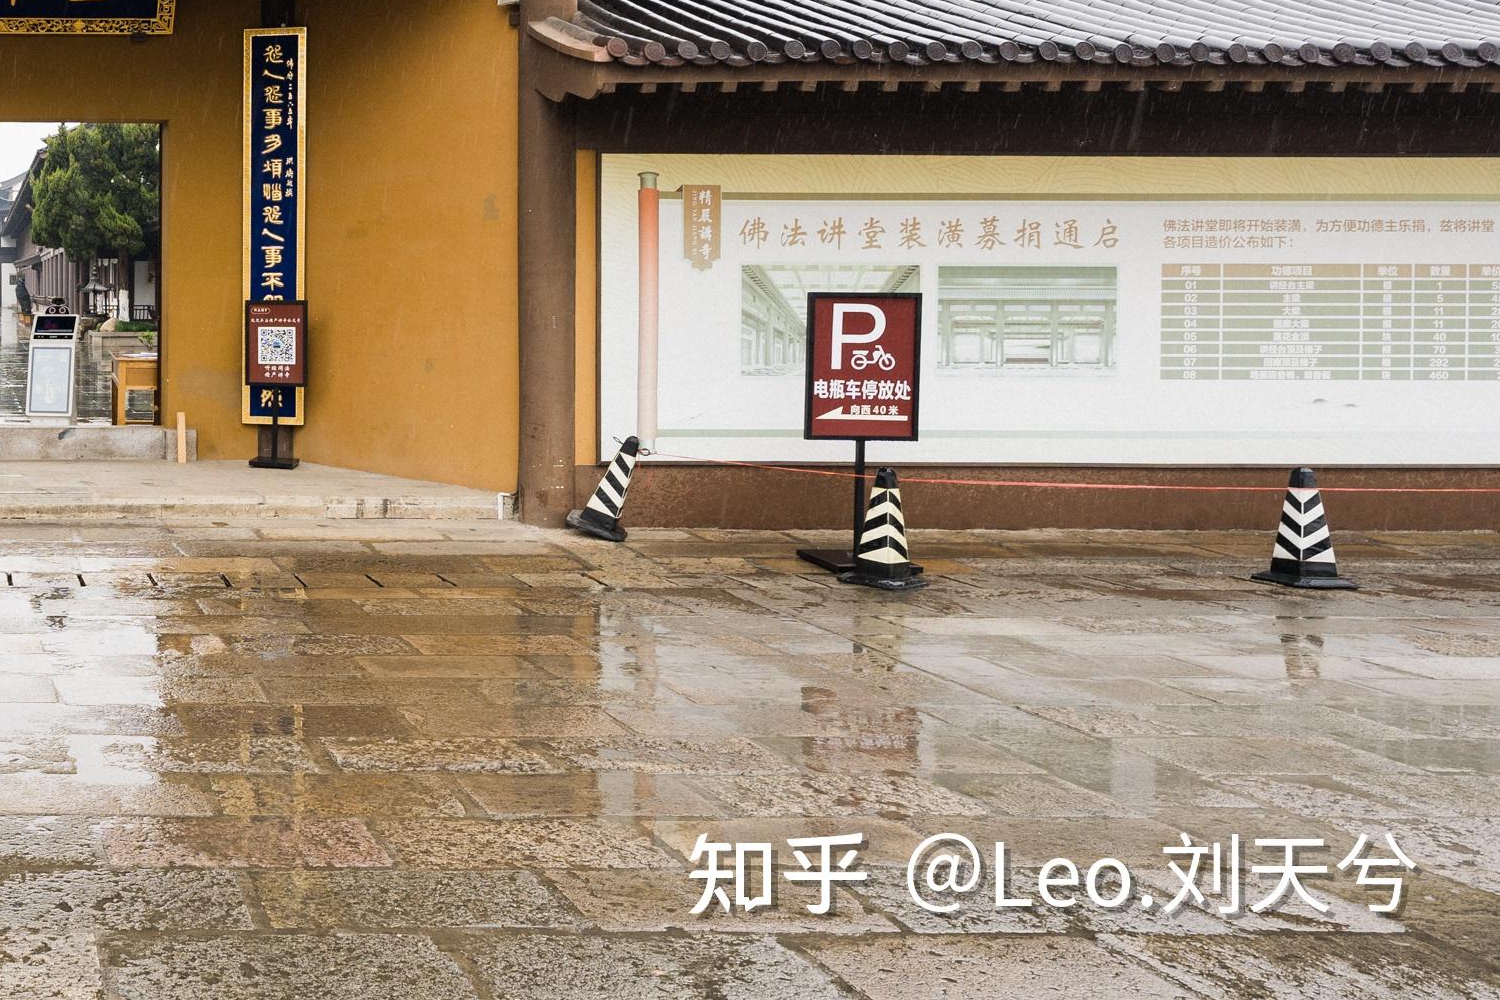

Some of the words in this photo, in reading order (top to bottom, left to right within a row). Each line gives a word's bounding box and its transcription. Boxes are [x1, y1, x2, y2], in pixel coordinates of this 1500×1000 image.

[739, 217, 1122, 251] 佛法讲堂装潢募捐通启
[1437, 282, 1442, 290] 1
[1436, 294, 1443, 302] 5
[1434, 308, 1444, 316] 11
[1433, 320, 1443, 328] 11
[831, 303, 887, 370] P
[1432, 332, 1446, 341] 40
[1434, 346, 1446, 354] 70
[1429, 358, 1449, 367] 292
[813, 379, 912, 401] 电瓶车停放处
